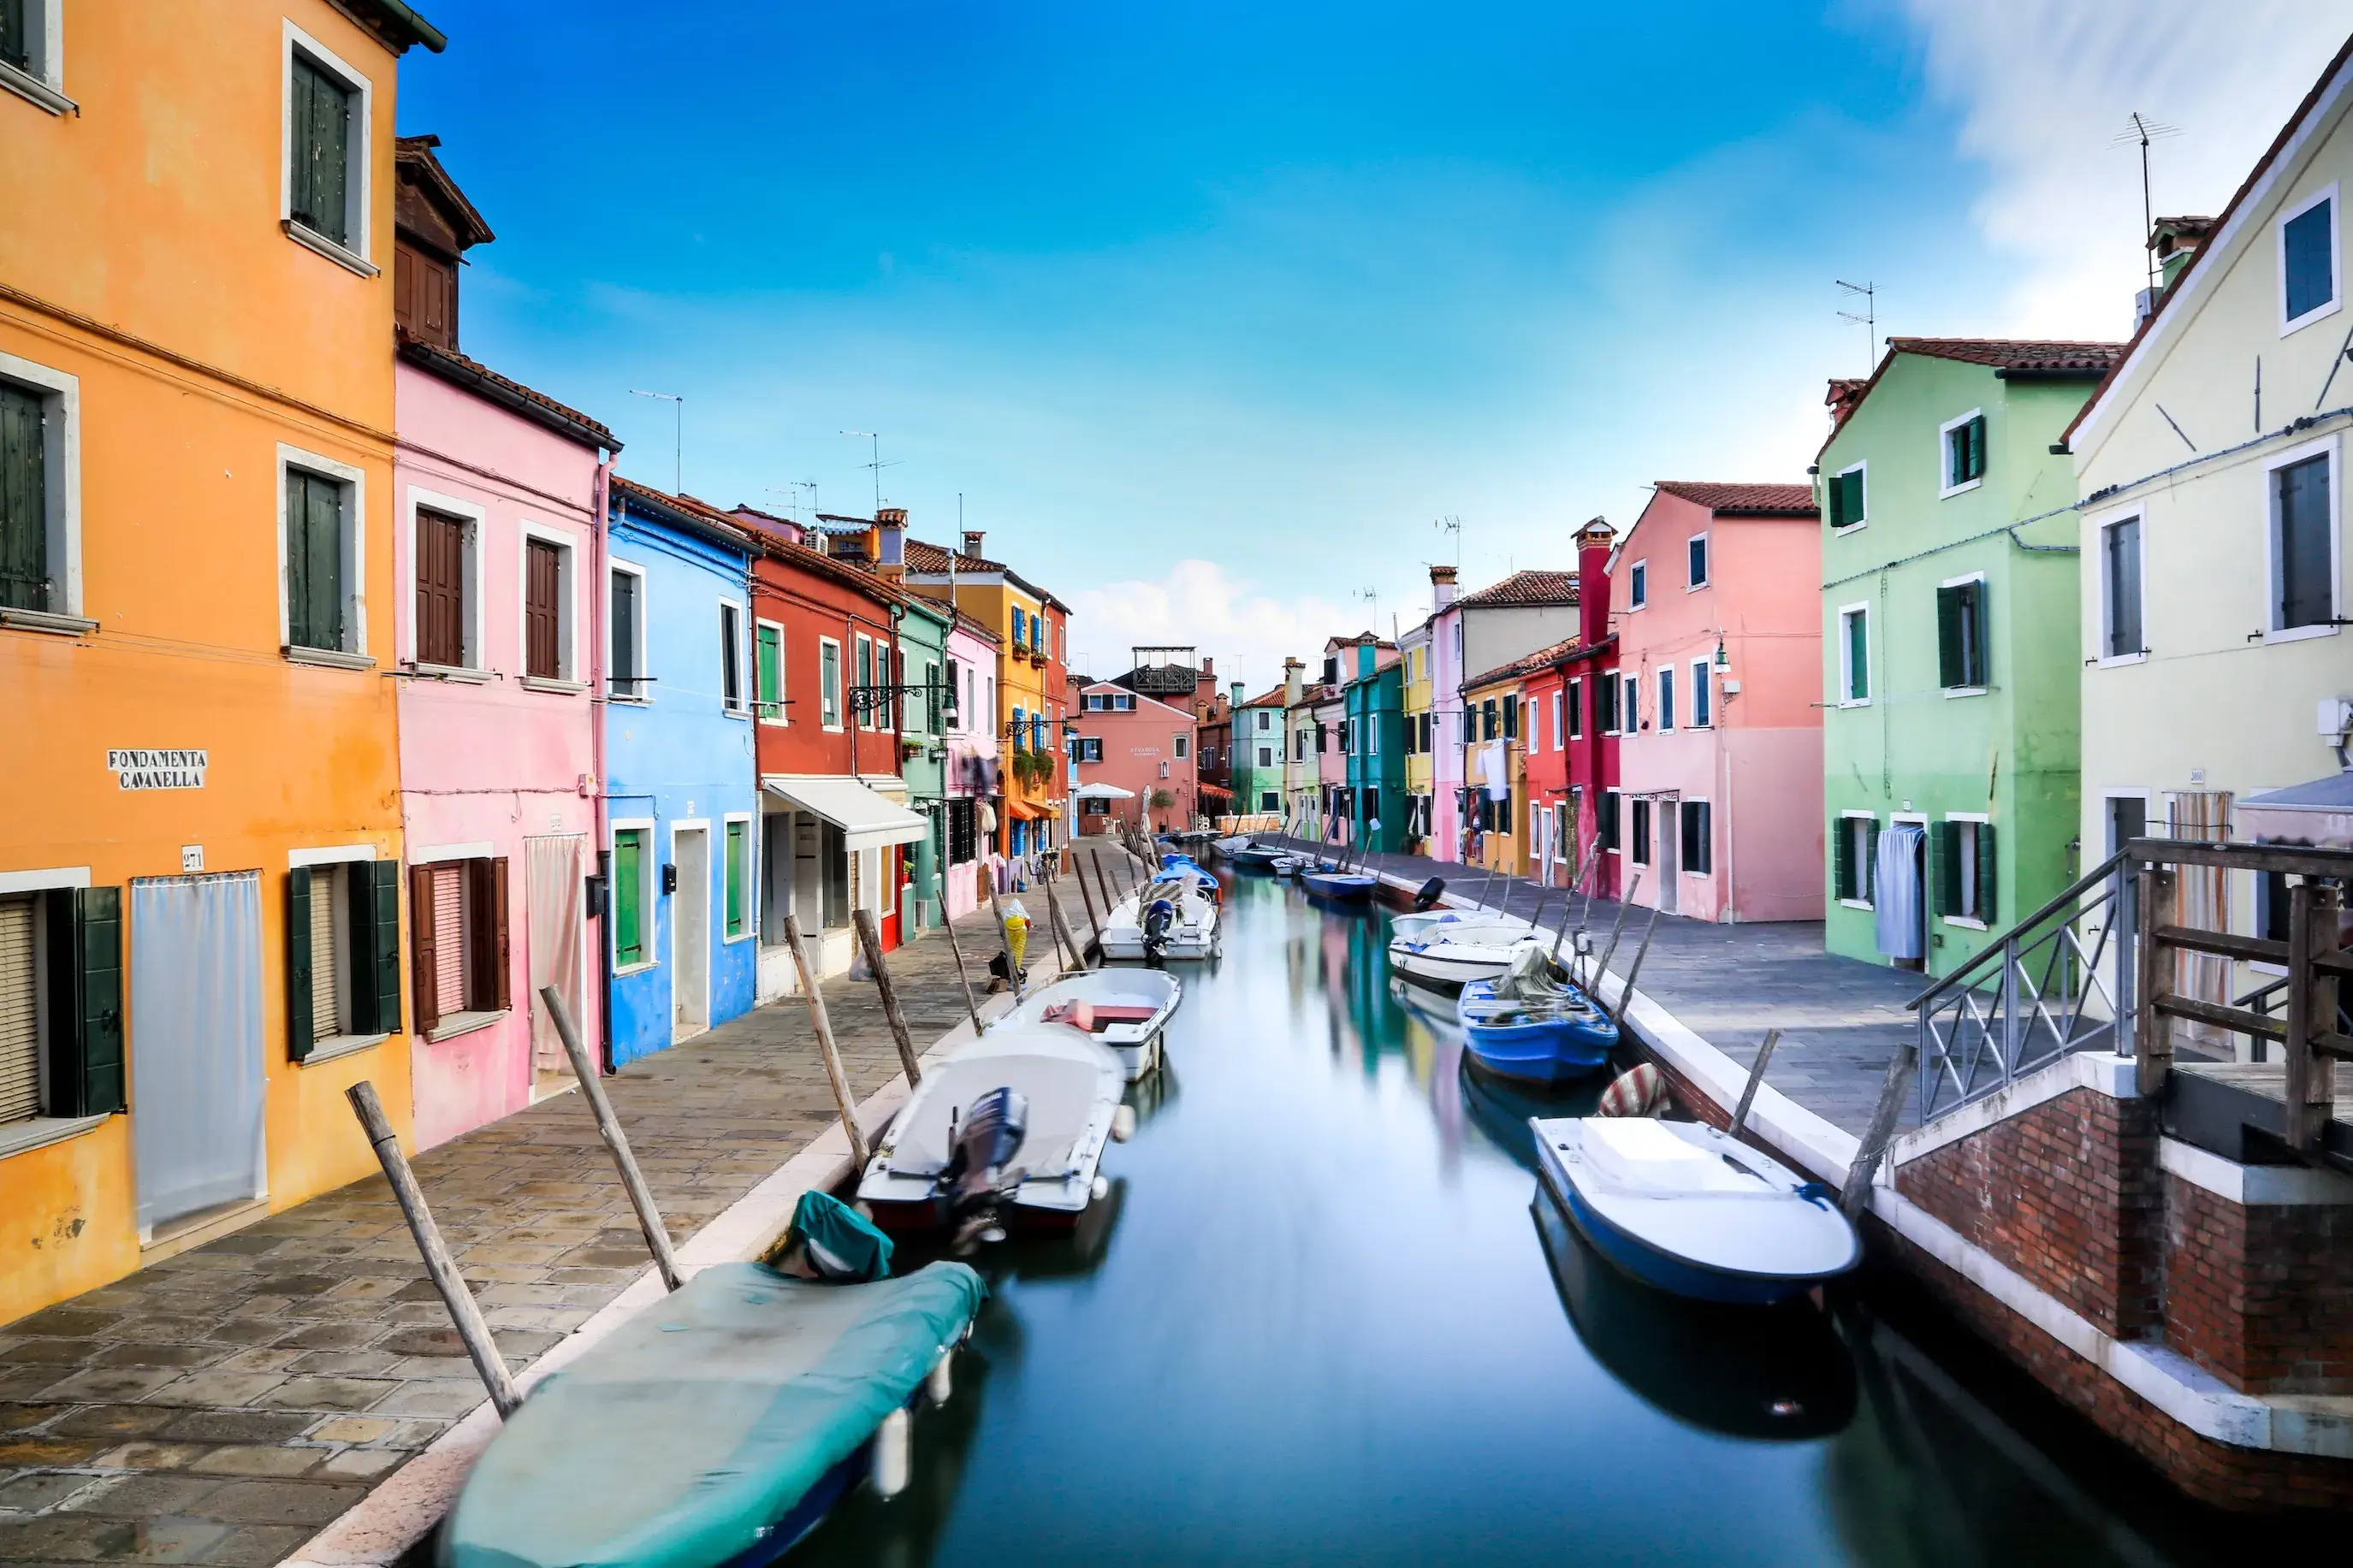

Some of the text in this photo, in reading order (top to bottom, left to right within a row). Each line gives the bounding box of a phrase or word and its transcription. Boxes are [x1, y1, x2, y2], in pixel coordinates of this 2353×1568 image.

[109, 751, 206, 768] FONDAMENTA
[120, 771, 201, 789] CAVANELLA
[183, 853, 202, 868] 271
